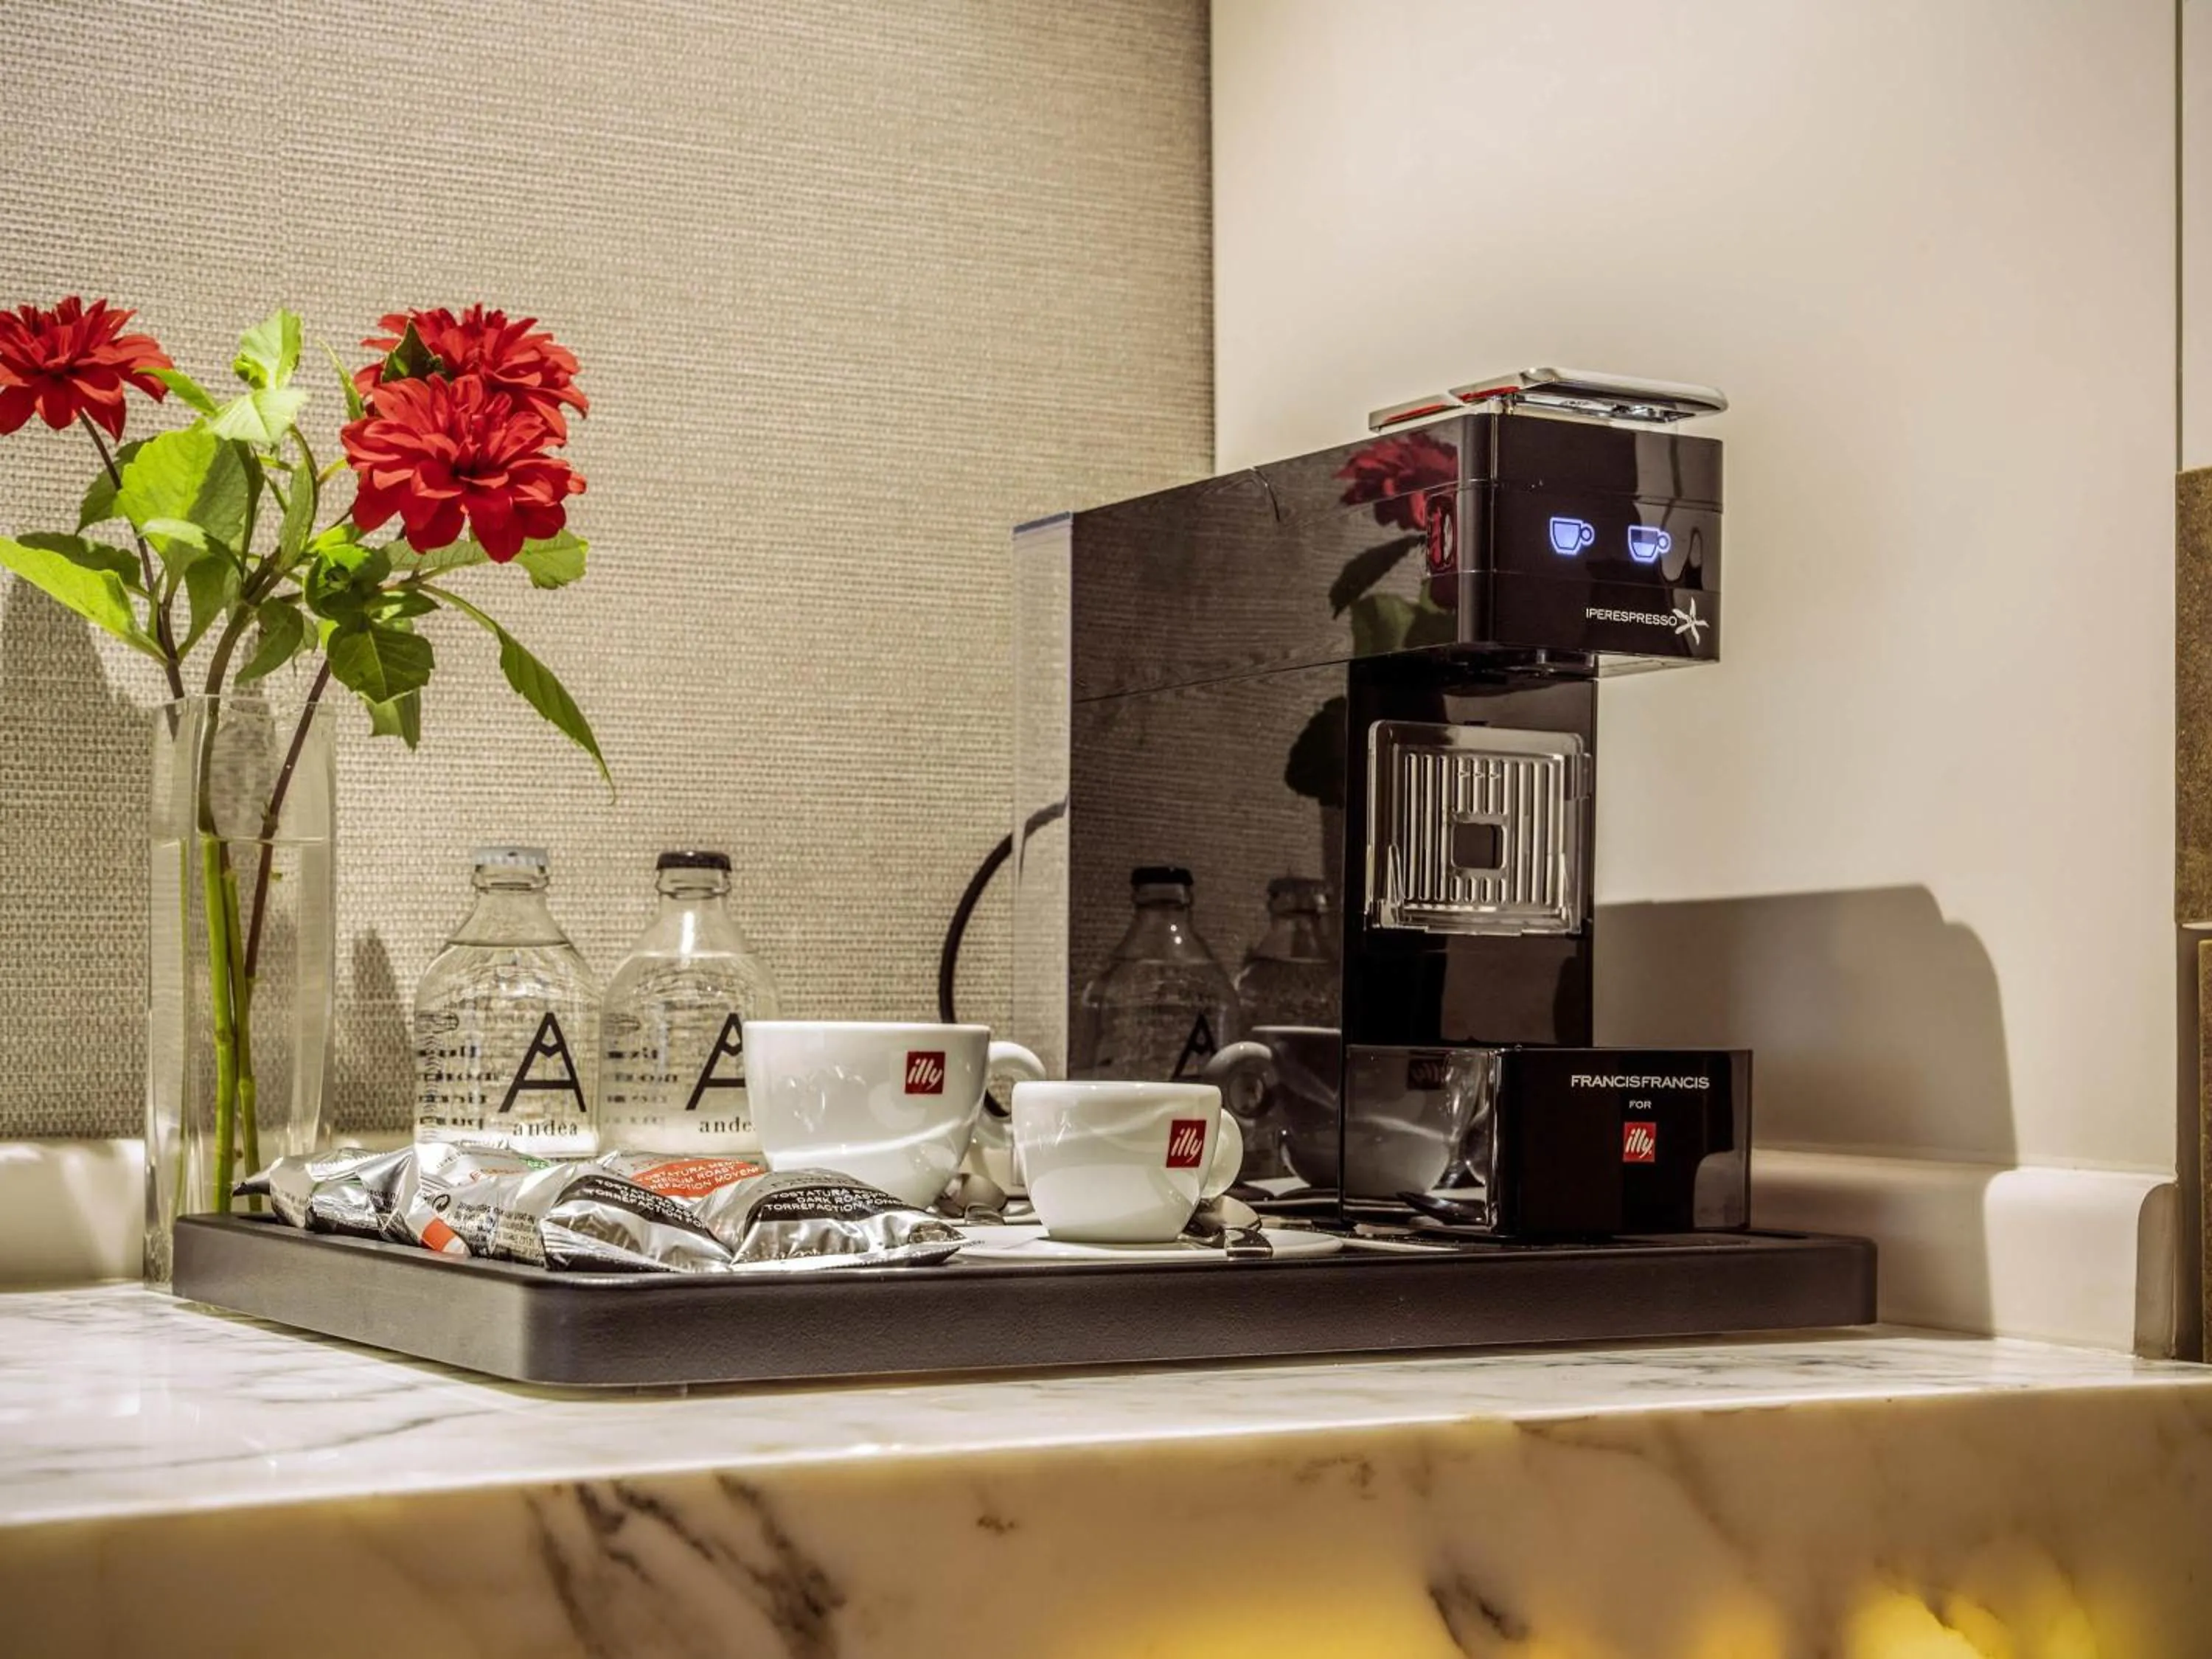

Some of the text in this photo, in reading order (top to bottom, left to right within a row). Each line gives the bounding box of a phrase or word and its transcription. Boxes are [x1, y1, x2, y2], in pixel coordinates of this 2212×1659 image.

[1586, 608, 1677, 626] IPERESPRESSO
[498, 1012, 587, 1113] A
[685, 1012, 746, 1110] A
[908, 1059, 943, 1088] illy
[1571, 1075, 1711, 1089] FRANCISFRANCIS
[1629, 1100, 1652, 1109] FOR
[512, 1120, 578, 1136] andea
[699, 1117, 756, 1133] ande
[1171, 1128, 1202, 1163] illy
[1625, 1127, 1654, 1158] illy
[764, 1200, 863, 1212] TORREFACTION
